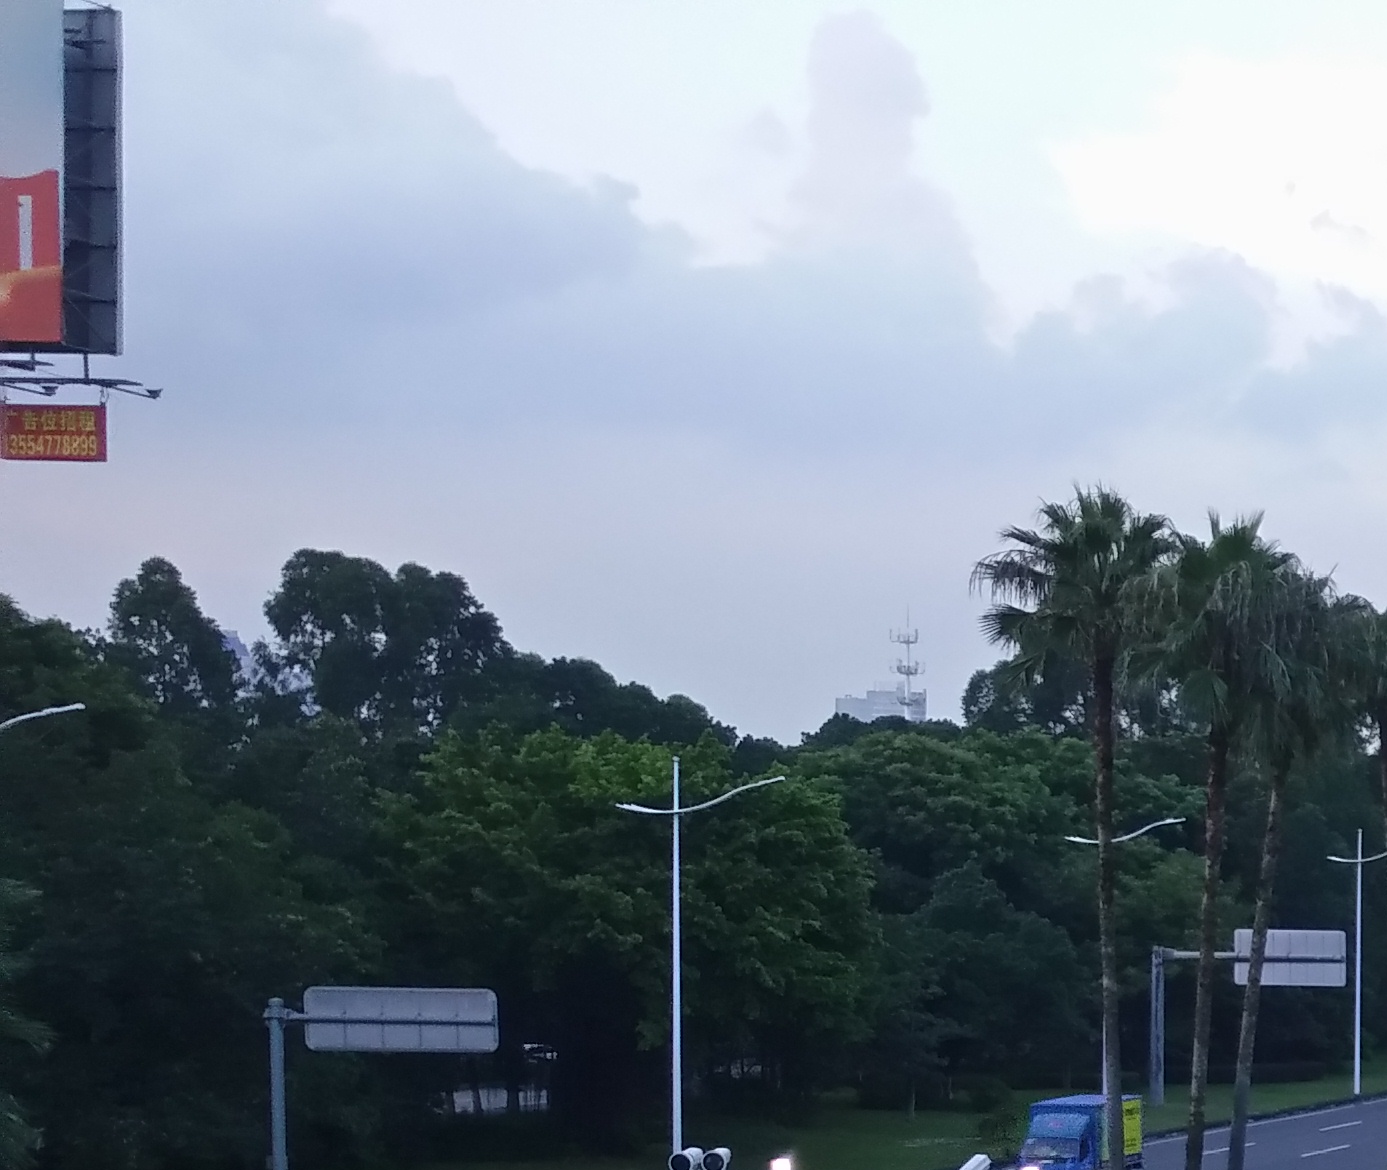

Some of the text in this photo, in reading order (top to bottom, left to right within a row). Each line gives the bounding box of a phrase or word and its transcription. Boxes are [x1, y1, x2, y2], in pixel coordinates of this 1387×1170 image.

[5, 410, 95, 431] 广告位招租
